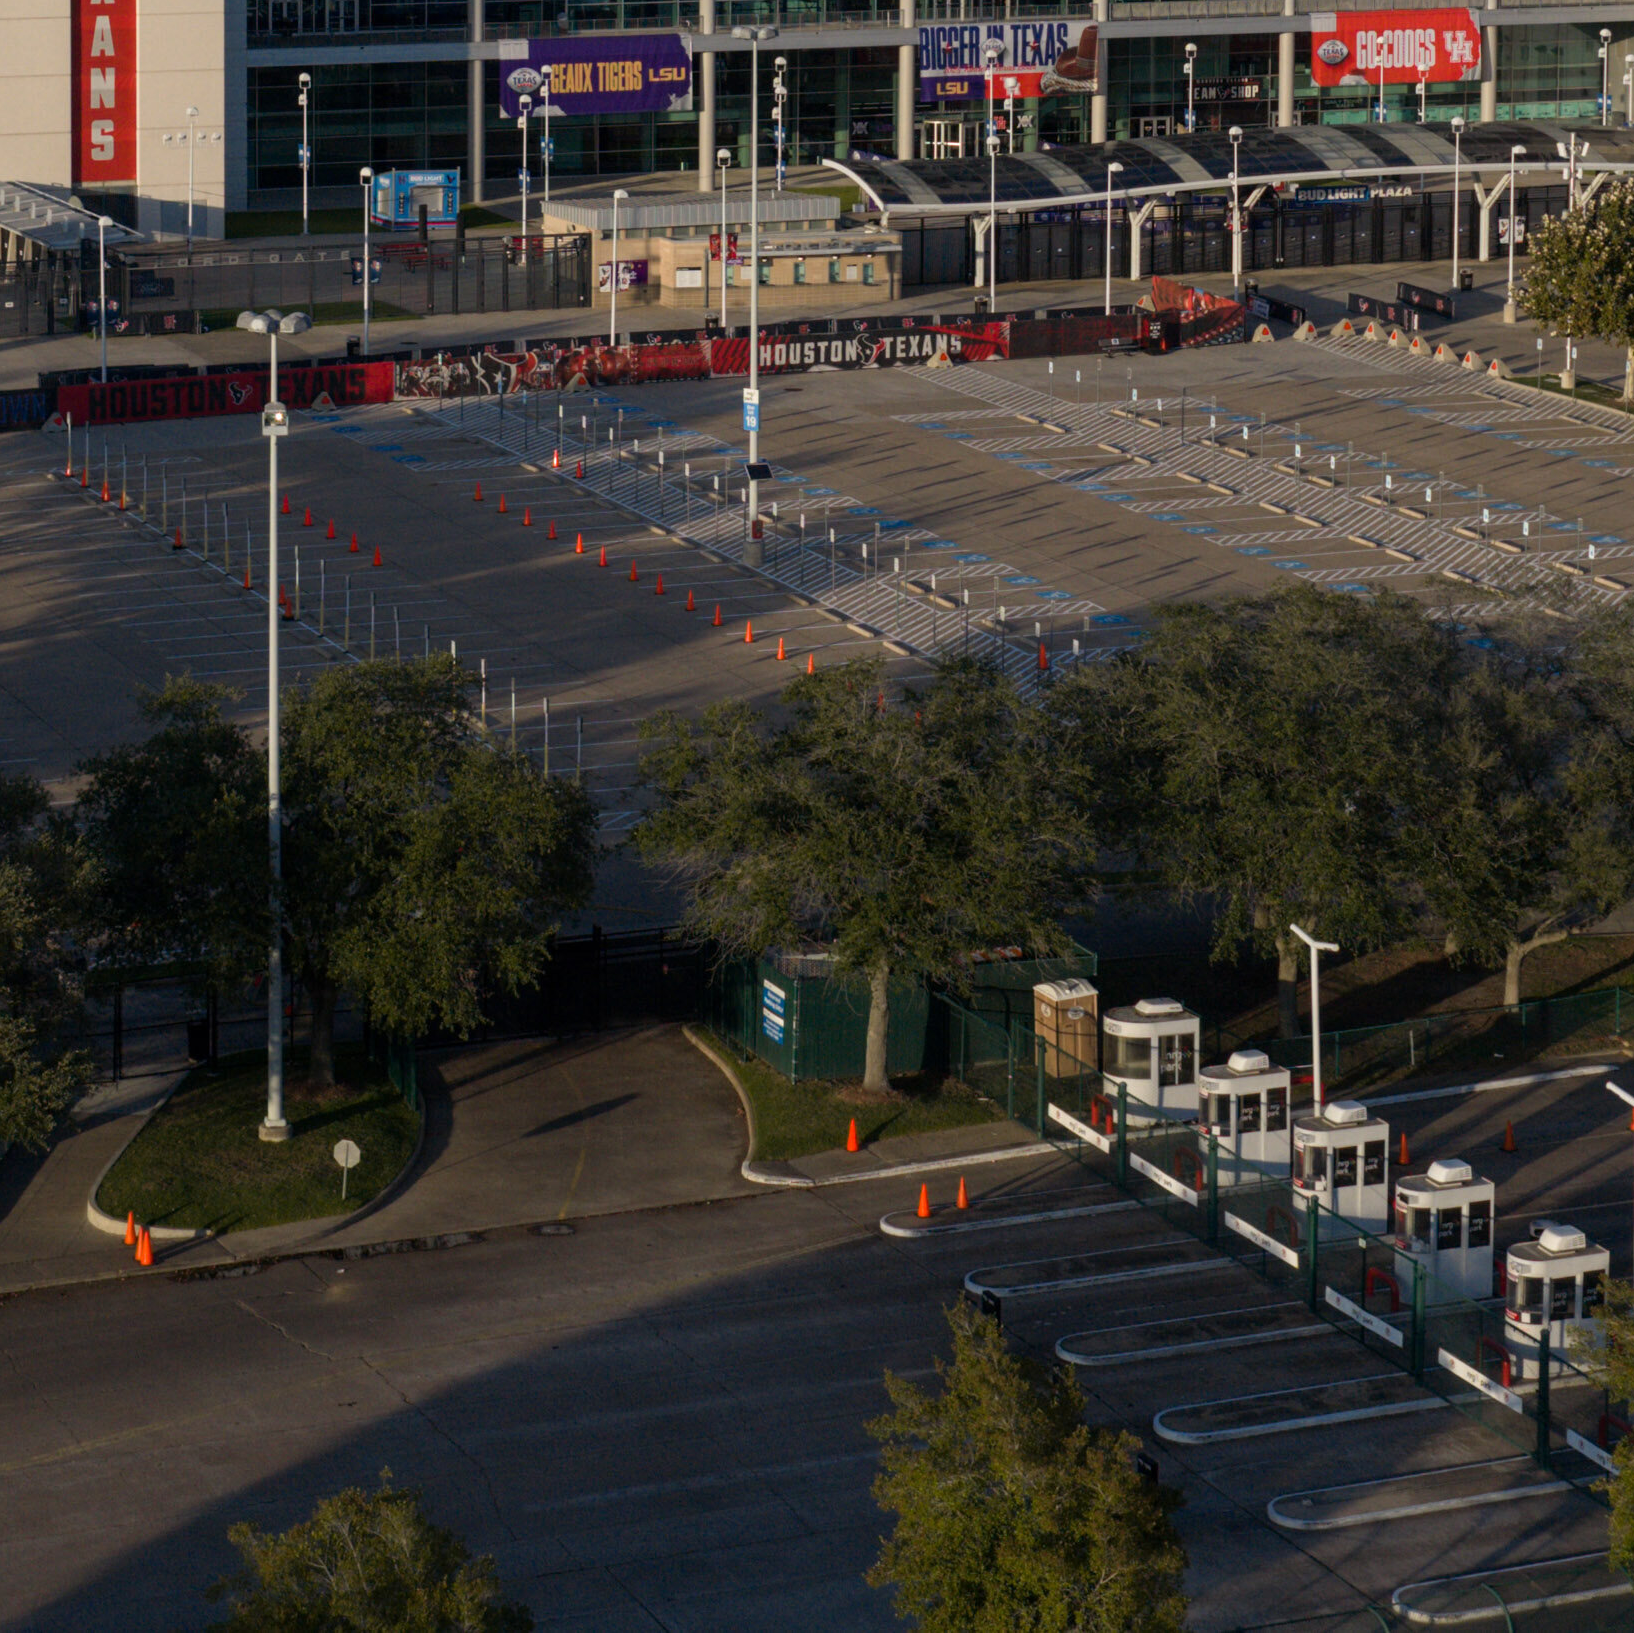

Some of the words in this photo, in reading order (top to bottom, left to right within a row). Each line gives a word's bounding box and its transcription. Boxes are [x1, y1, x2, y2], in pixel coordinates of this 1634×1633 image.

[919, 26, 980, 71] BIGGER
[1011, 23, 1069, 67] TEXAS
[1323, 47, 1344, 56] TEXAS
[1356, 30, 1379, 69] GO
[1382, 28, 1436, 68] COOGS
[512, 76, 537, 86] TEXAS
[550, 62, 593, 94] GEAUX
[597, 61, 643, 93] TIGERS
[648, 67, 686, 82] LSU
[936, 81, 969, 96] LSU
[1230, 85, 1259, 99] SHOP
[1298, 189, 1327, 202] BUD
[1327, 187, 1367, 201] LIGHT
[1369, 186, 1413, 199] PLAZA
[269, 250, 351, 264] GATE
[759, 341, 857, 367] HOUSTON
[882, 334, 962, 359] TEXANS
[89, 379, 227, 421] HOUSTON
[255, 368, 366, 411] TEXANS
[746, 416, 756, 427] 19
